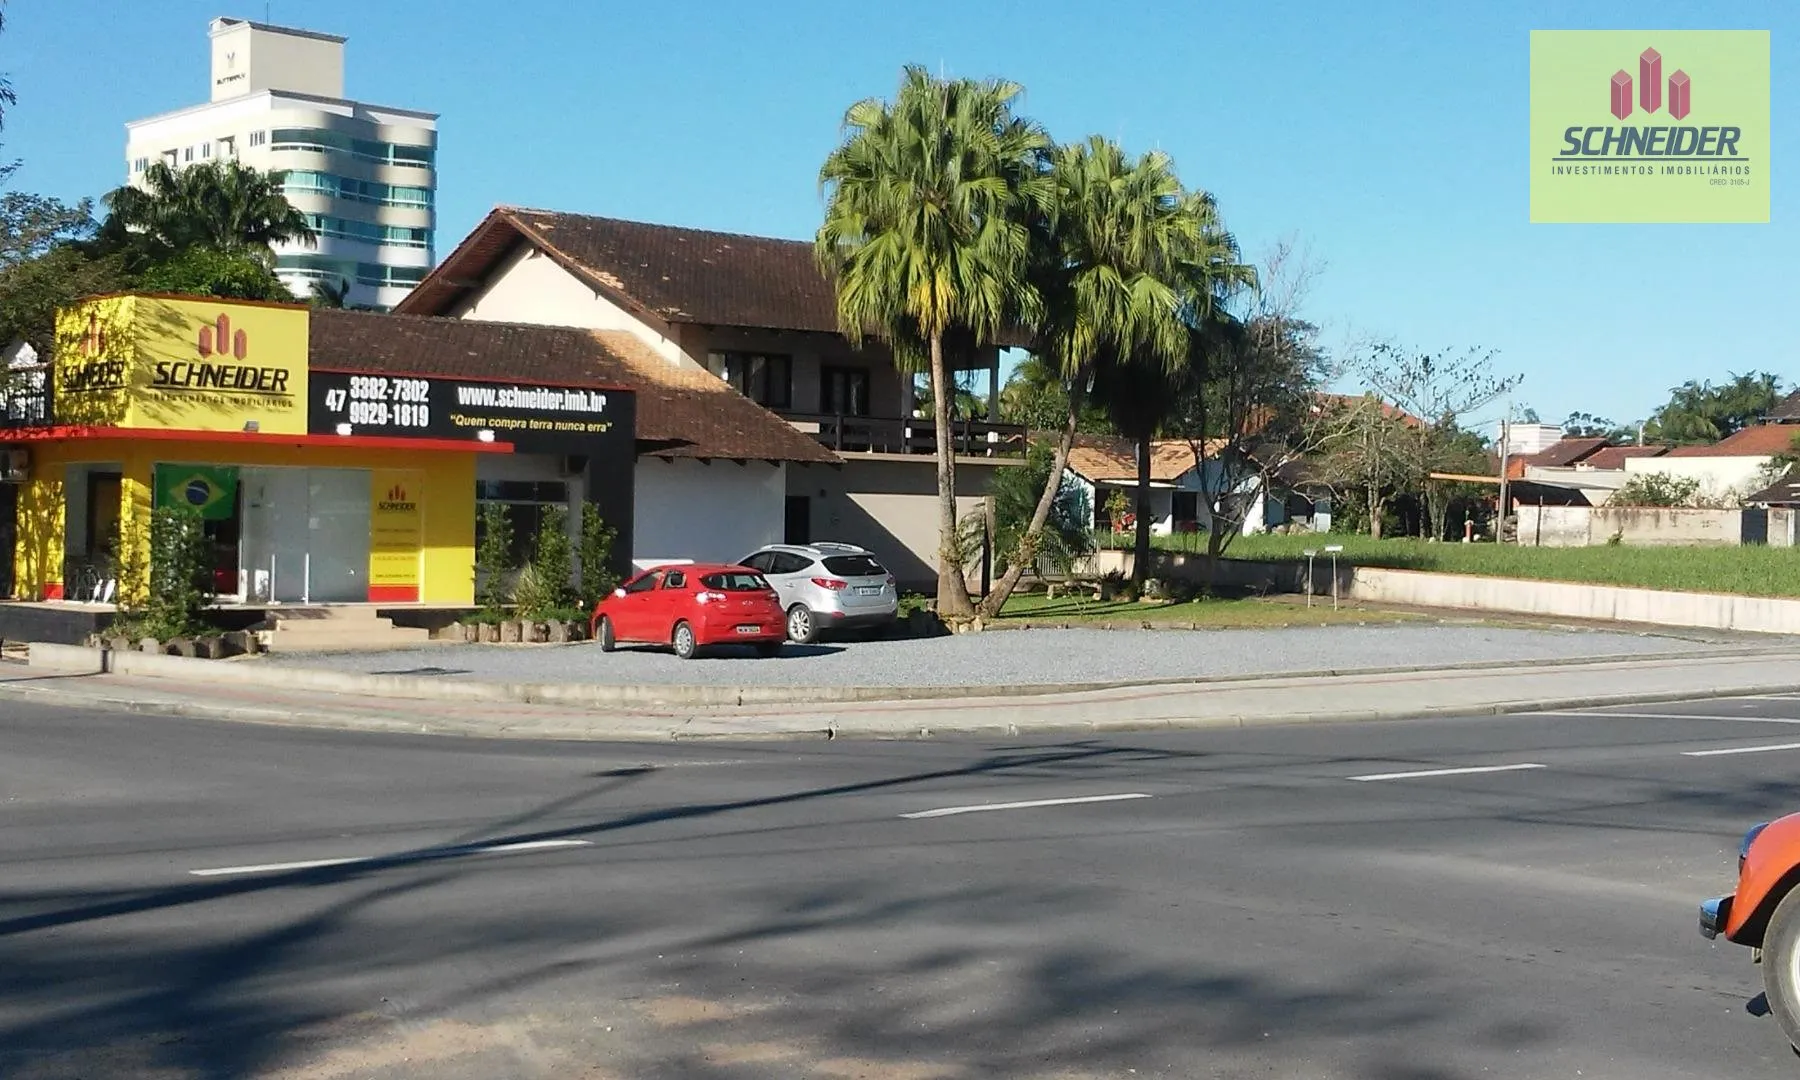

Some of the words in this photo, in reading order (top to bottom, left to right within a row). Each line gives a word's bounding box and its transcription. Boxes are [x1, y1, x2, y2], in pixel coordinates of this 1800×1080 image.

[153, 361, 289, 392] SCHNEIDER
[350, 376, 429, 402] 3382-7302
[325, 389, 347, 412] 47
[458, 386, 606, 412] www.schneider.imb.br
[349, 401, 429, 427] 9929-1819
[488, 418, 527, 430] compra
[529, 420, 553, 430] terra
[555, 422, 586, 432] nunca
